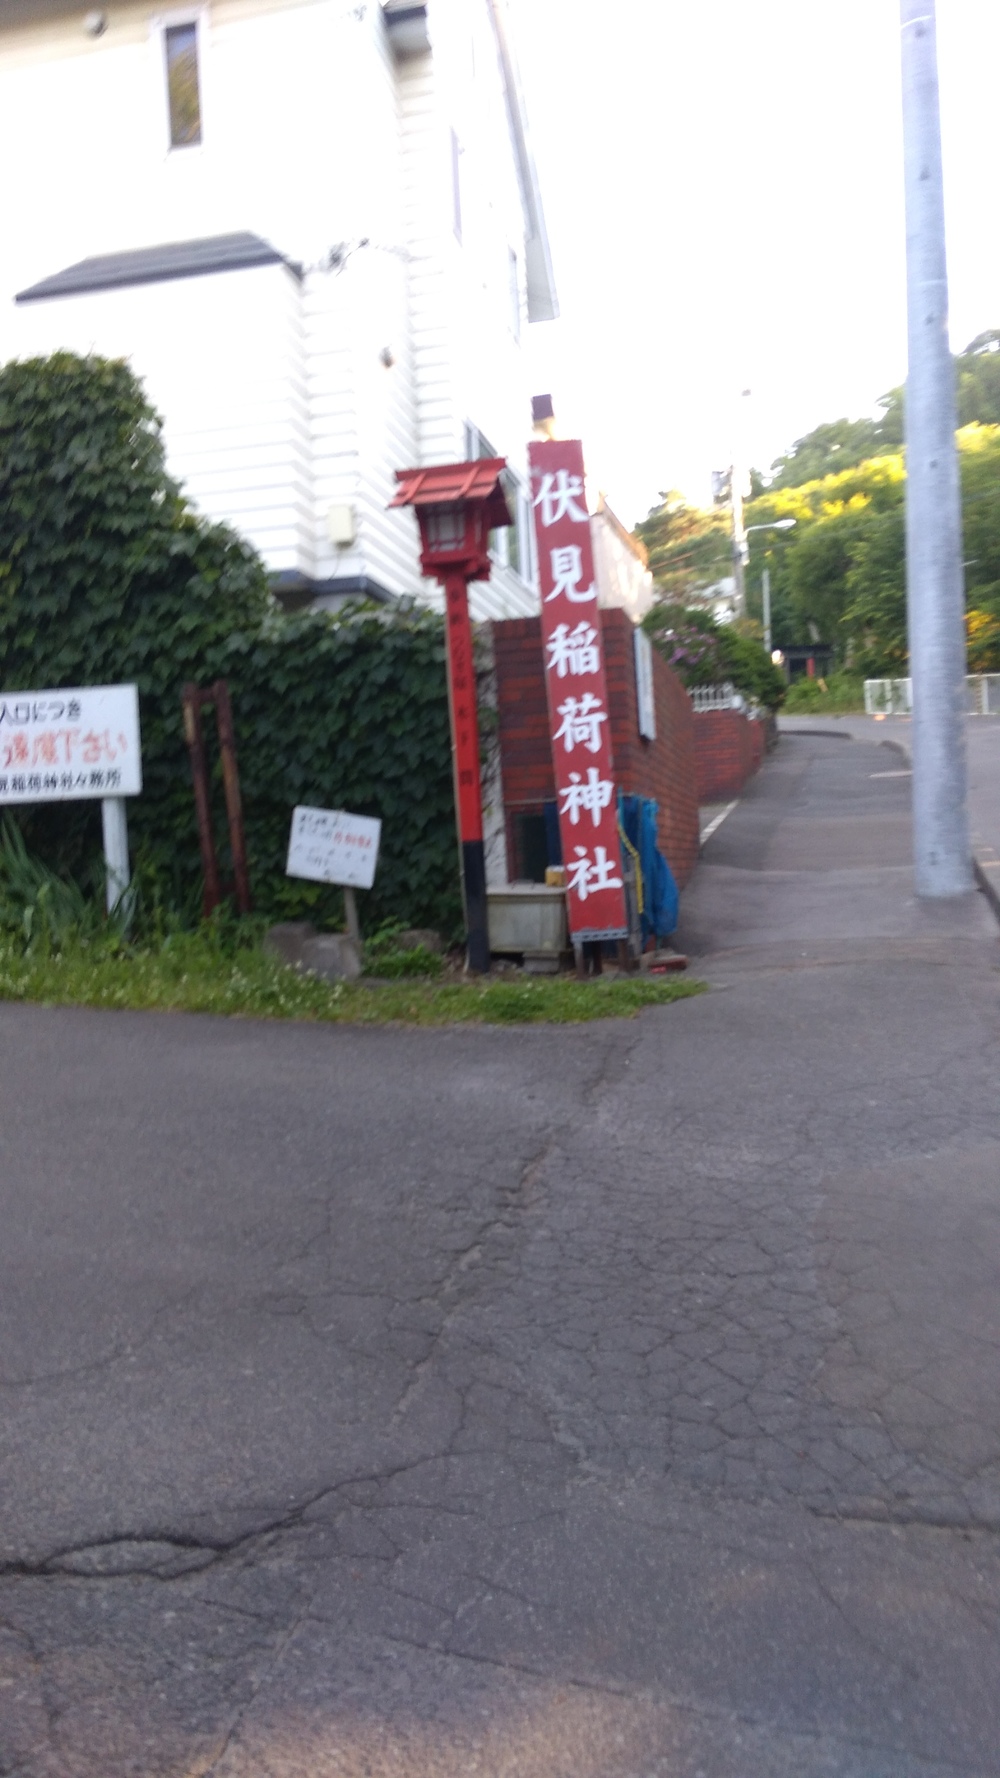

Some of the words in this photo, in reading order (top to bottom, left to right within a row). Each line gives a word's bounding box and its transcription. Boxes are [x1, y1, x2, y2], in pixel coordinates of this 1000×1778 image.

[534, 469, 624, 902] 伏見稲荷神社
